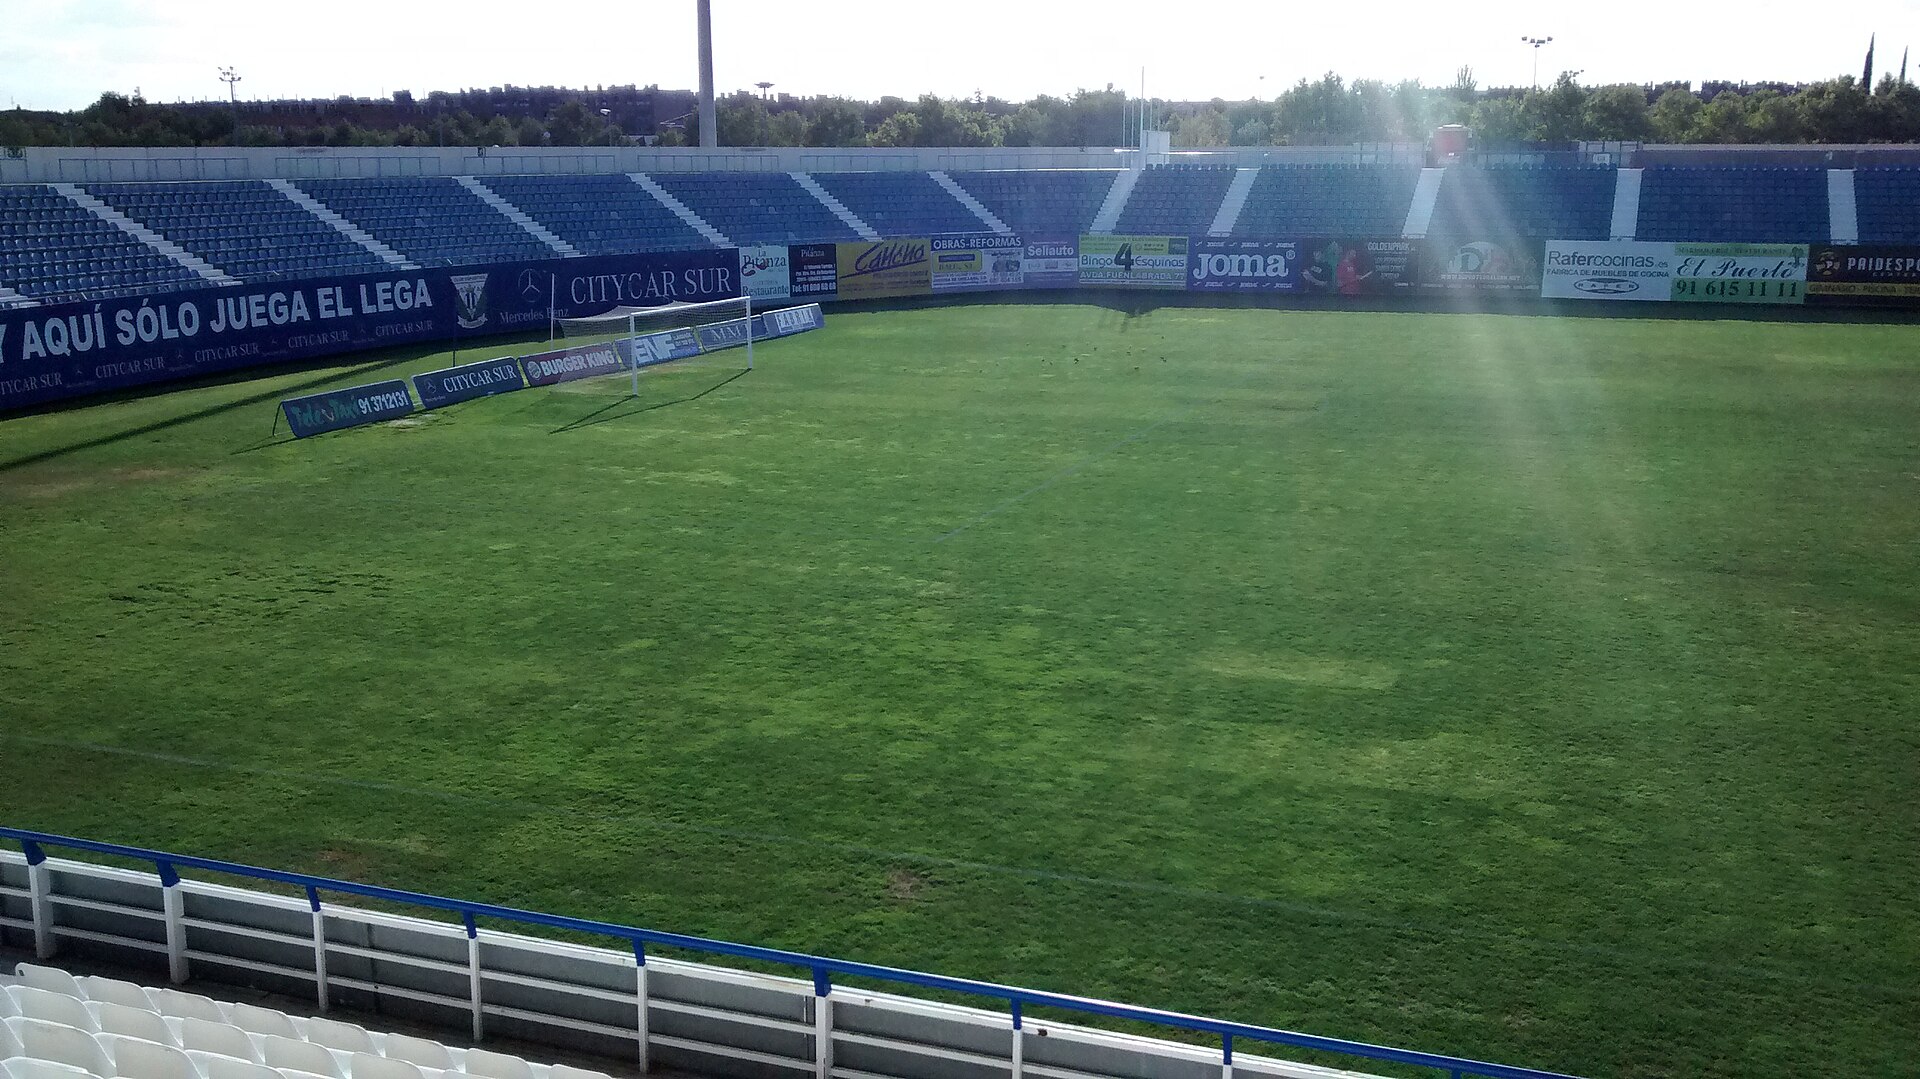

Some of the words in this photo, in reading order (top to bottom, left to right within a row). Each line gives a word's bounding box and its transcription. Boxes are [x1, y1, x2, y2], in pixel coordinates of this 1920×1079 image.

[933, 236, 1022, 250] OBRAS-REFORMAS
[742, 254, 787, 268] Pitanza
[1081, 254, 1113, 269] Bingo
[1114, 243, 1135, 271] 4
[1135, 255, 1185, 269] Esquinas
[1640, 270, 1670, 278] COCINA
[1676, 257, 1707, 277] El
[1711, 258, 1794, 279] Puerto
[571, 270, 678, 305] CITYCAR
[684, 267, 733, 296] SUR
[742, 285, 789, 297] Restaurante
[1676, 280, 1697, 295] 91
[1705, 280, 1740, 296] 615
[1748, 281, 1767, 297] 11
[1777, 281, 1797, 297] 11
[22, 303, 106, 361] AQUÍ
[115, 298, 200, 346] SÓLO
[209, 290, 311, 333] JUEGA
[316, 286, 353, 319] EL
[359, 278, 433, 314] LEGA
[500, 309, 544, 324] Mercedes
[375, 323, 413, 338] CITYCAR
[413, 320, 434, 334] SUR
[712, 324, 748, 341] MM
[288, 333, 329, 348] CITYCAR
[330, 330, 350, 343] SUR
[195, 345, 238, 363] CITYCAR
[239, 342, 260, 356] SUR
[95, 359, 142, 379] CITYCAR
[143, 355, 166, 372] SUR
[540, 356, 583, 377] BURGER
[583, 349, 615, 367] KING
[40, 371, 63, 388] SUR
[443, 369, 494, 393] CITYCAR
[495, 364, 517, 379] SUR
[358, 397, 372, 414] 91
[371, 390, 409, 412] 3712131
